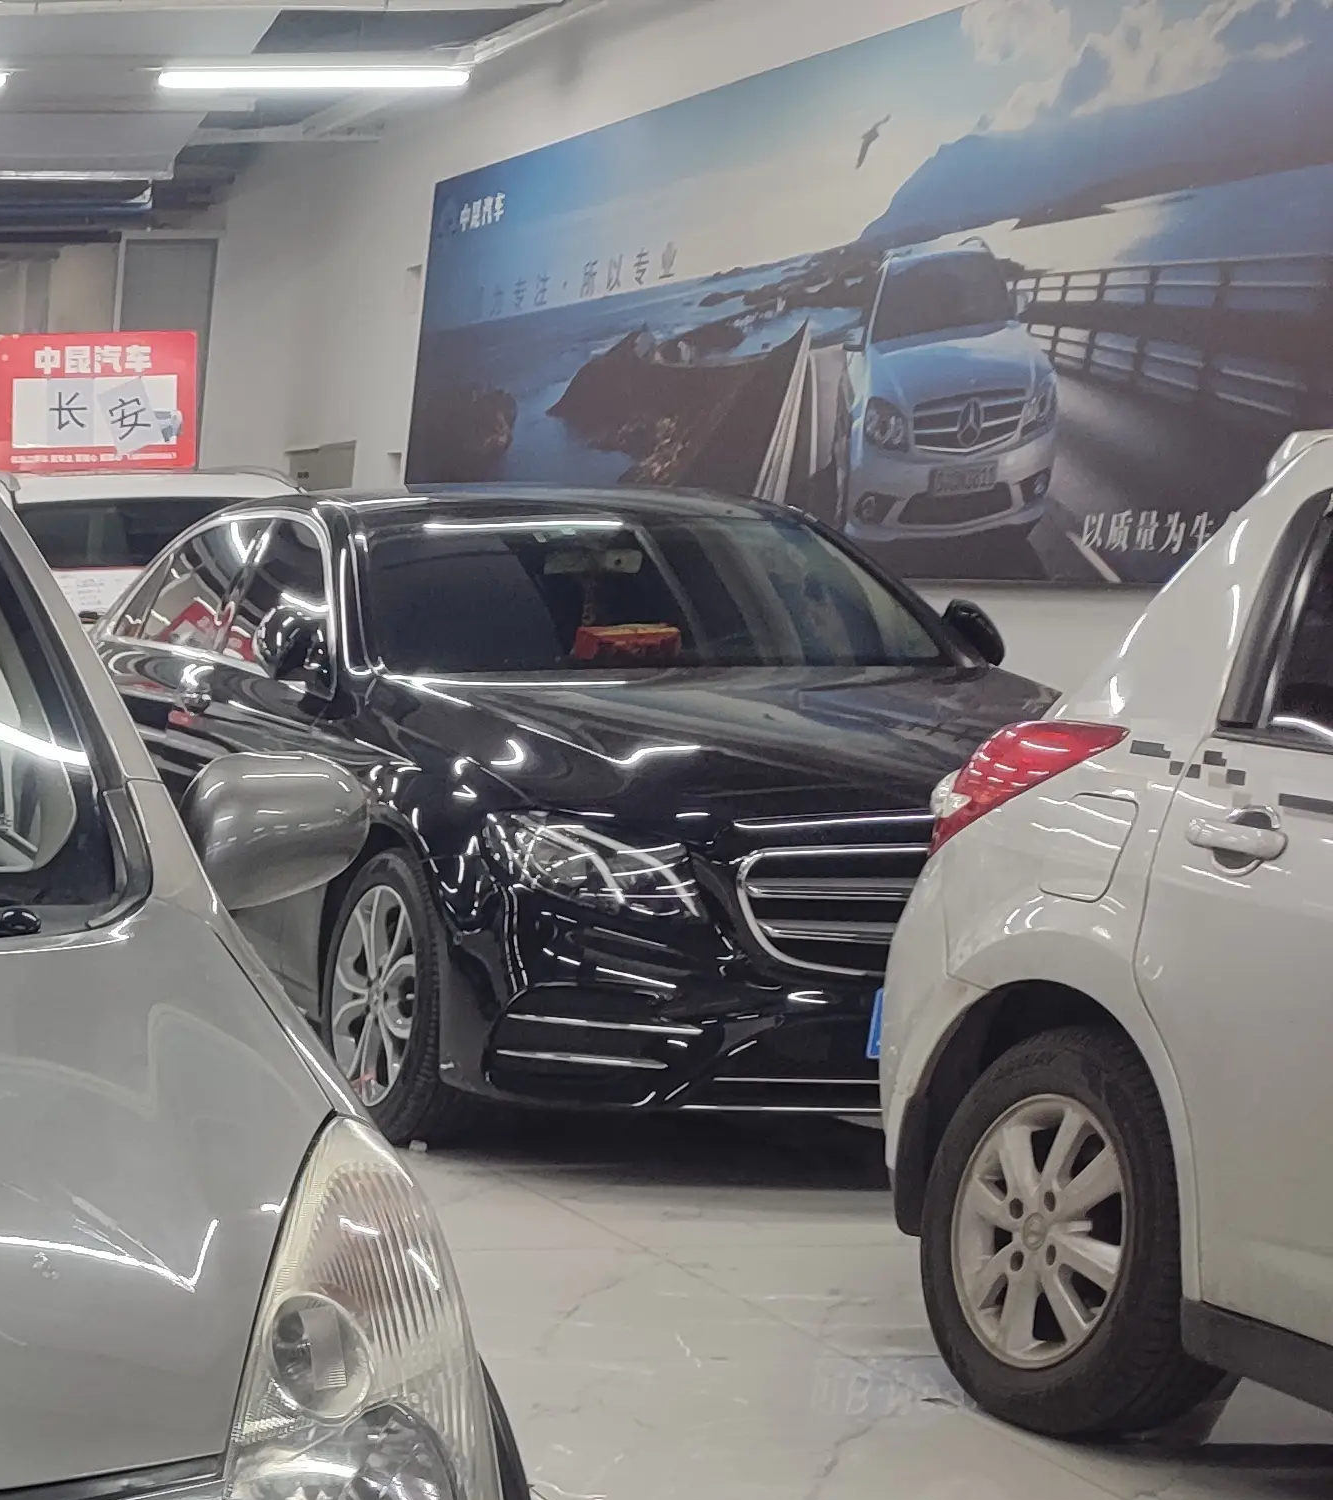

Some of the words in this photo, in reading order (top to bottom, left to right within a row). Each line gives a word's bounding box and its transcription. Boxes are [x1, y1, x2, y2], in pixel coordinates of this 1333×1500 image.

[34, 344, 153, 375] 中昆汽车
[48, 391, 152, 441] 长安
